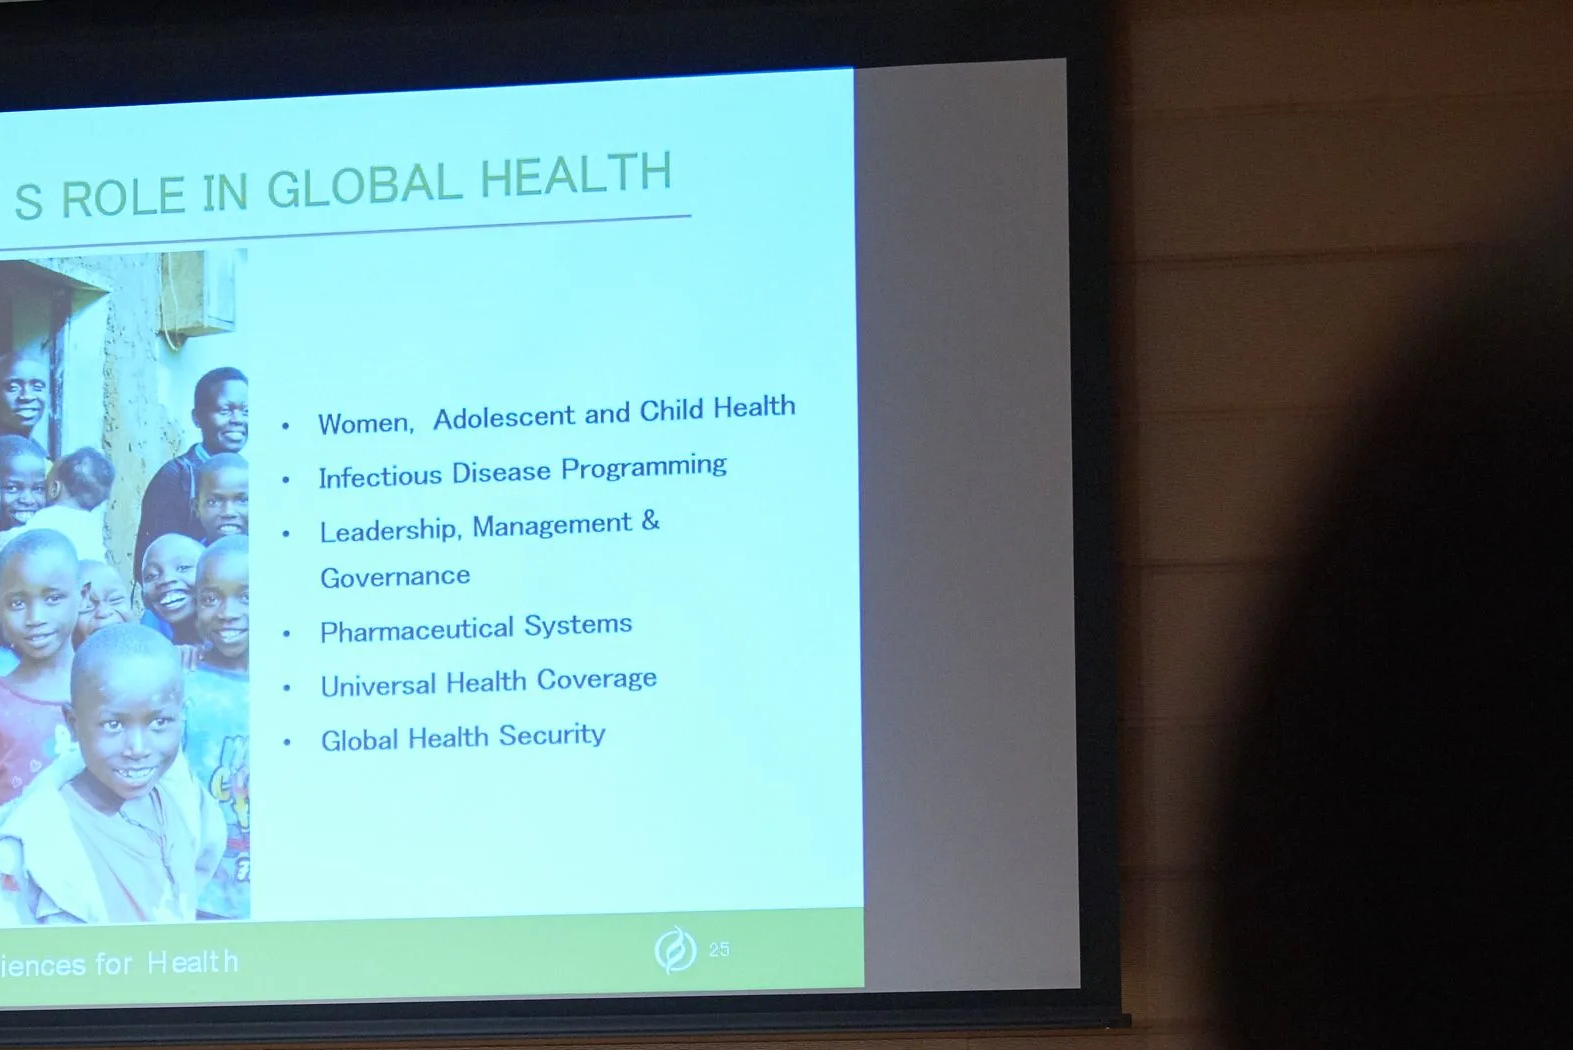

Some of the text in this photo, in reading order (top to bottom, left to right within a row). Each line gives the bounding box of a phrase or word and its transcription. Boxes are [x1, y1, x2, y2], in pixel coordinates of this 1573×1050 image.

[63, 176, 186, 219] ROLE
[203, 172, 247, 212] IN
[268, 162, 464, 209] GLOBAL
[482, 150, 671, 198] HEALTH
[318, 393, 796, 436] Women, Adolescent and Child Health
[319, 452, 728, 489] Infectious Disease Programming
[321, 508, 660, 543] Leadership, Management &
[320, 567, 471, 589] Governance
[321, 614, 633, 644] Pharmaceutical Systems
[321, 668, 657, 698] Universal Health Coverage
[321, 722, 606, 752] Global Health Security
[95, 951, 133, 976] for
[148, 948, 238, 974] Health
[709, 941, 730, 957] 25
